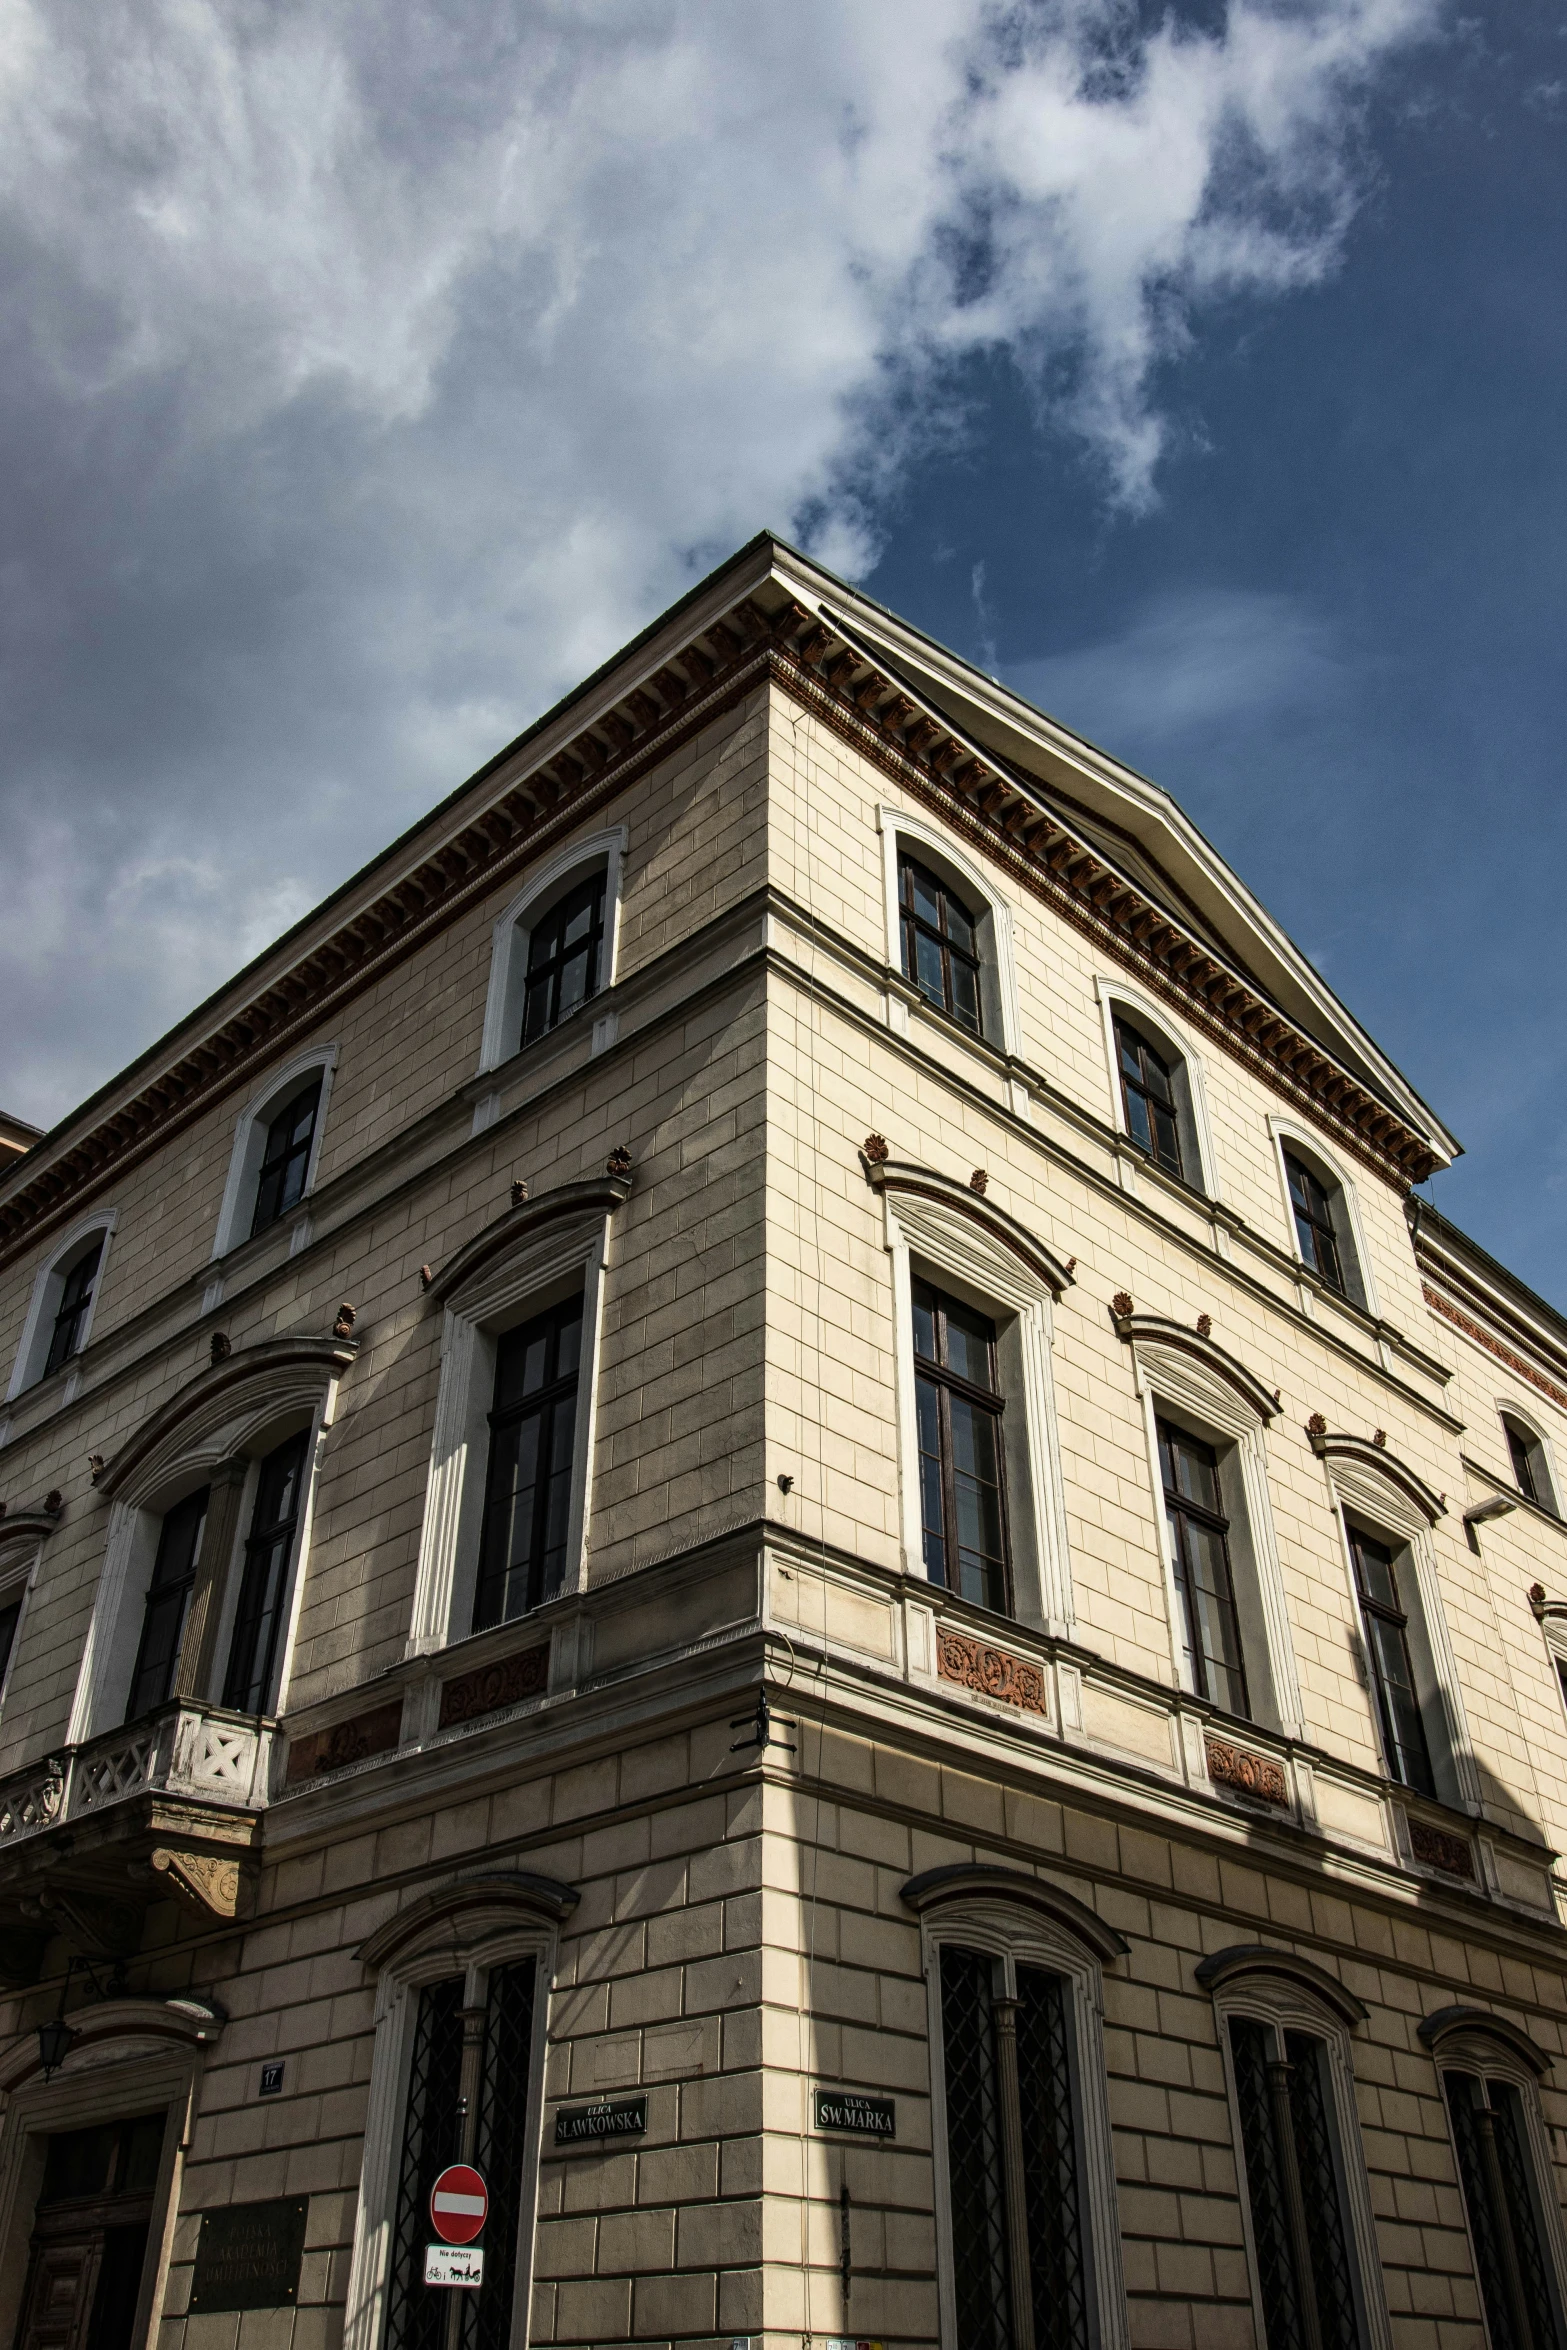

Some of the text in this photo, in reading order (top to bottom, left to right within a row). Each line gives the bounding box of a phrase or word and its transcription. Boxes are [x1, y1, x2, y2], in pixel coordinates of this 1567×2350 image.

[265, 2070, 277, 2086] 17
[587, 2105, 612, 2116] ULICA
[844, 2097, 871, 2110] ULICA
[557, 2111, 643, 2139] SŁAWKOWSKA
[843, 2108, 893, 2131] MARKA
[439, 2249, 472, 2260] Nie dotyczy
